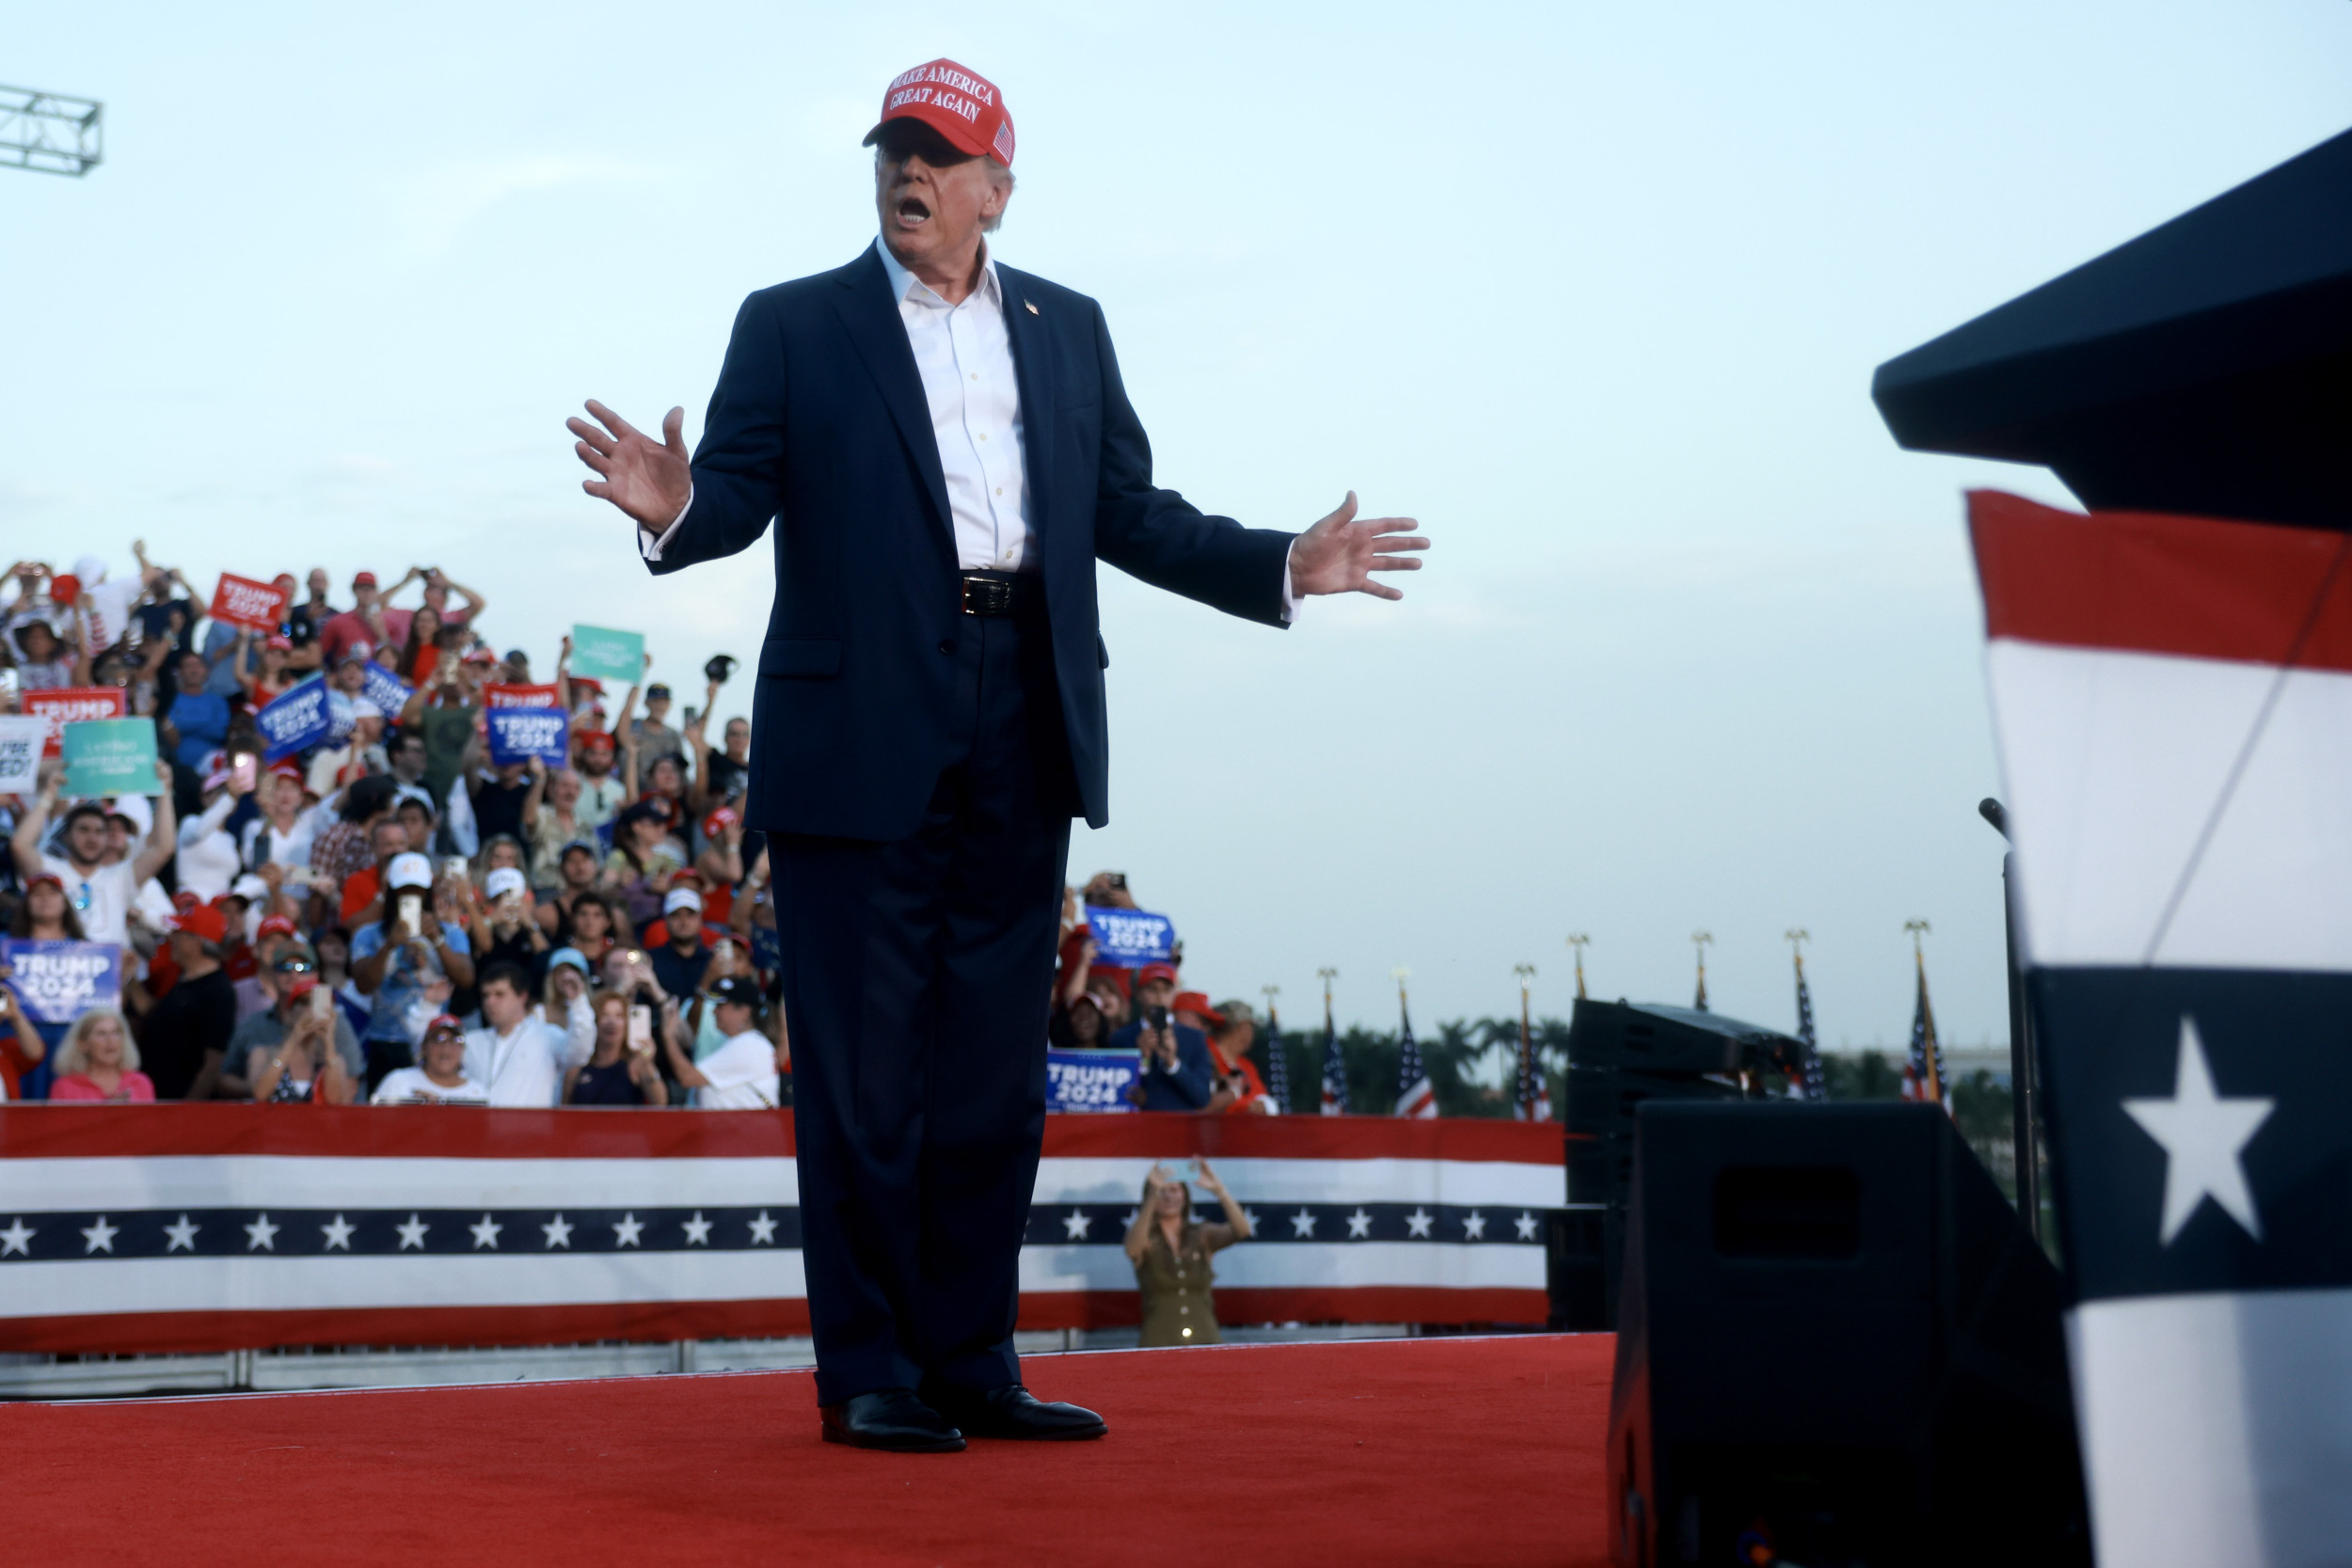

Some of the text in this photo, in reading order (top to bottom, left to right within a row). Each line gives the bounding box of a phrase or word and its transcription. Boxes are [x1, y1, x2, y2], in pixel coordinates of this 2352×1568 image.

[890, 66, 993, 107] MAKE AMERICA
[890, 87, 981, 124] GREAT AGAIN
[222, 579, 281, 606] TRUMP
[226, 595, 269, 618] 2024
[31, 699, 116, 721] TRUMP
[262, 688, 323, 731] TRUMP
[491, 691, 553, 708] TRUMP
[273, 708, 321, 741] 2024
[494, 716, 564, 734] TRUMP
[505, 730, 556, 749] 2024
[1093, 914, 1168, 933] TRUMP
[1108, 929, 1161, 949] 2024
[12, 954, 110, 978] TRUMP
[24, 975, 96, 997] 2024
[1047, 1063, 1132, 1087] TRUMP
[1055, 1081, 1118, 1104] 2024
